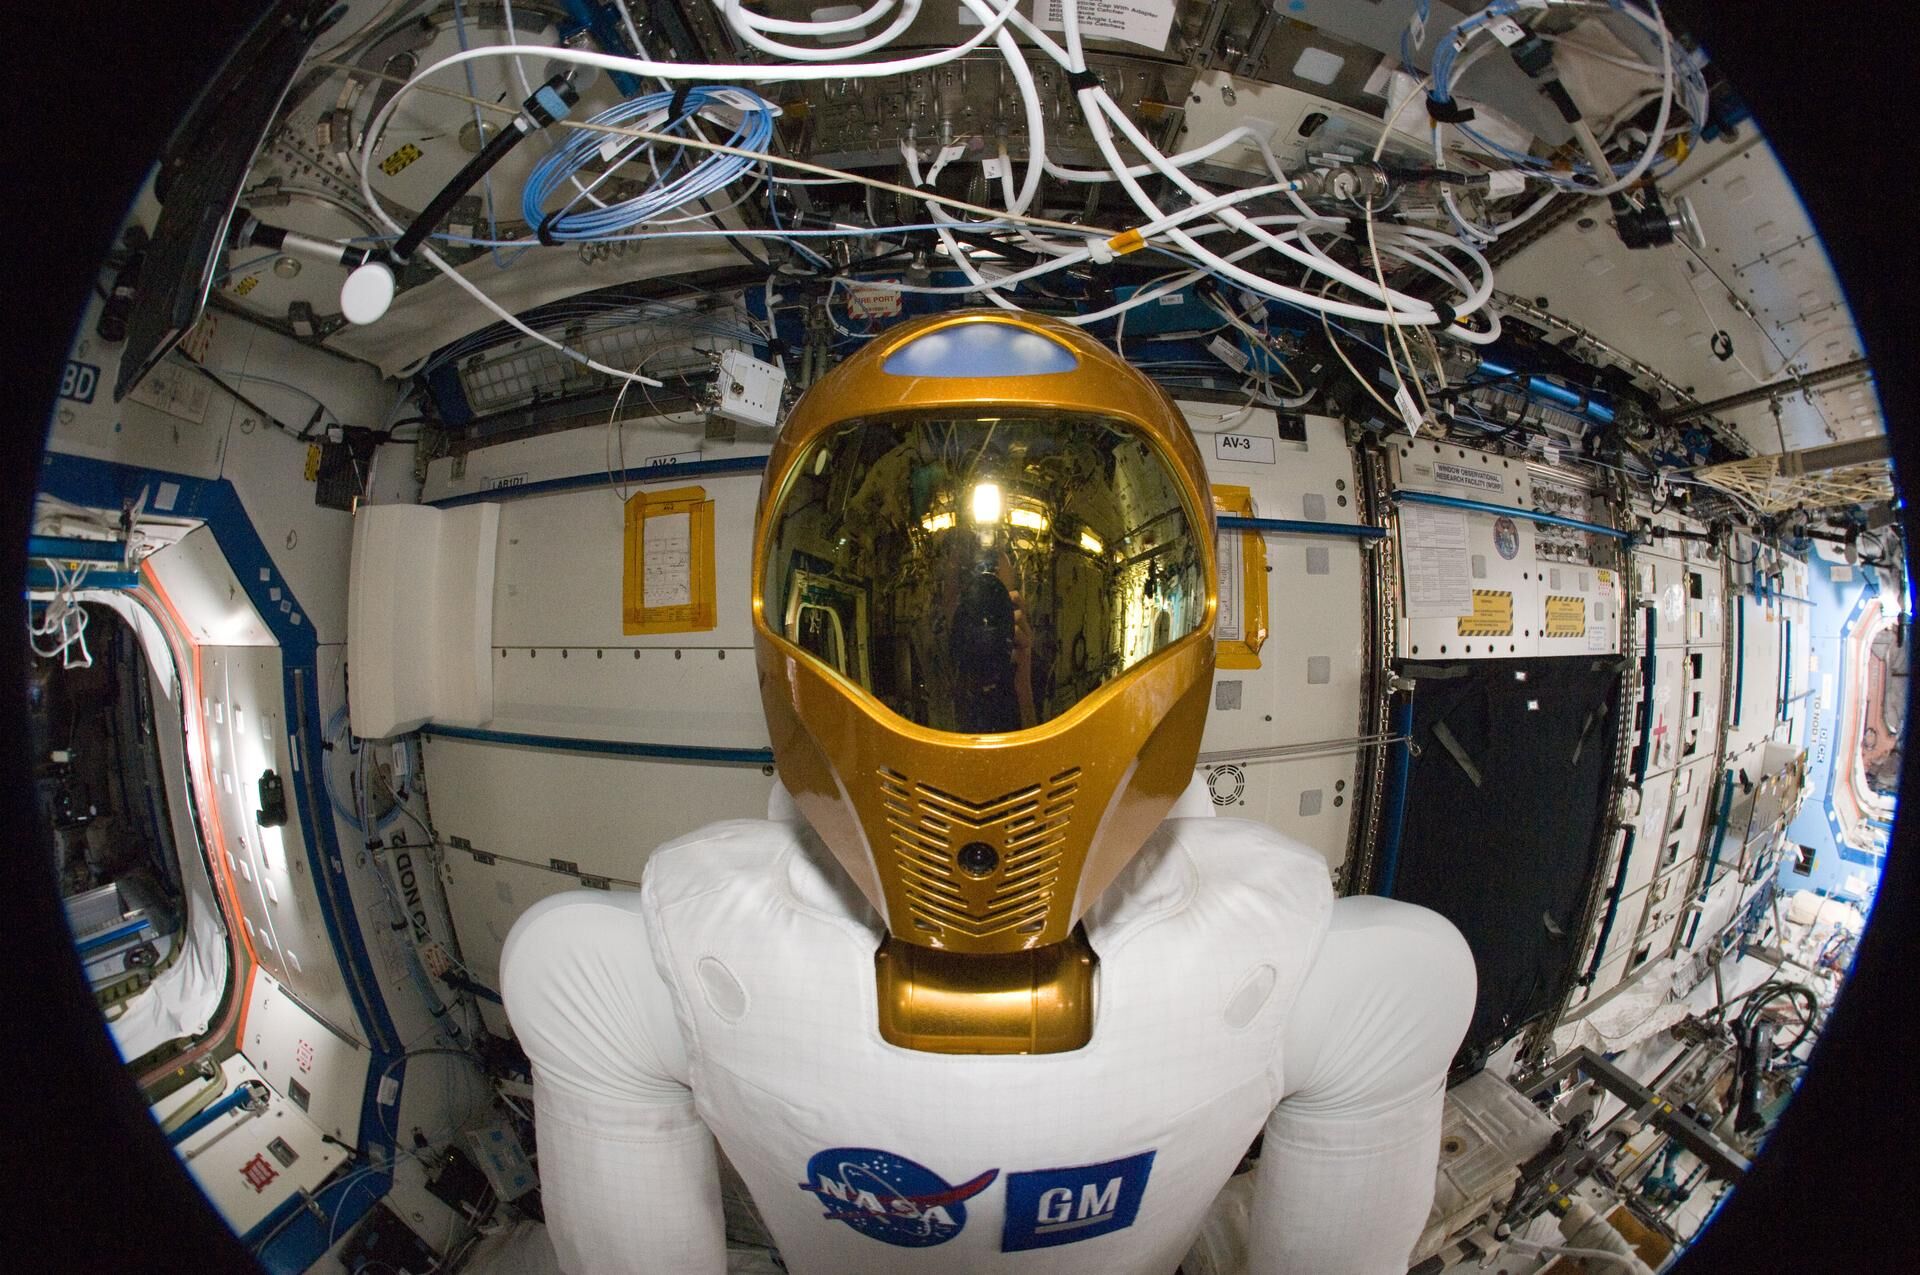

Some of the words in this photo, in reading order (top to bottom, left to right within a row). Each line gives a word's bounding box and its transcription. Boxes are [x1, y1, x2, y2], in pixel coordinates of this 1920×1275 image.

[1113, 3, 1130, 11] With
[1130, 7, 1159, 18] Adapter
[873, 295, 895, 304] PORT
[1222, 436, 1251, 450] AV-3
[652, 457, 677, 468] AV-2
[1814, 697, 1821, 710] TO
[1812, 713, 1820, 736] NOD
[1816, 728, 1828, 764] DECK
[391, 831, 408, 848] 2
[397, 853, 421, 907] NOD
[412, 911, 433, 944] TO
[817, 1174, 957, 1226] NASA
[1037, 1176, 1123, 1223] GM
